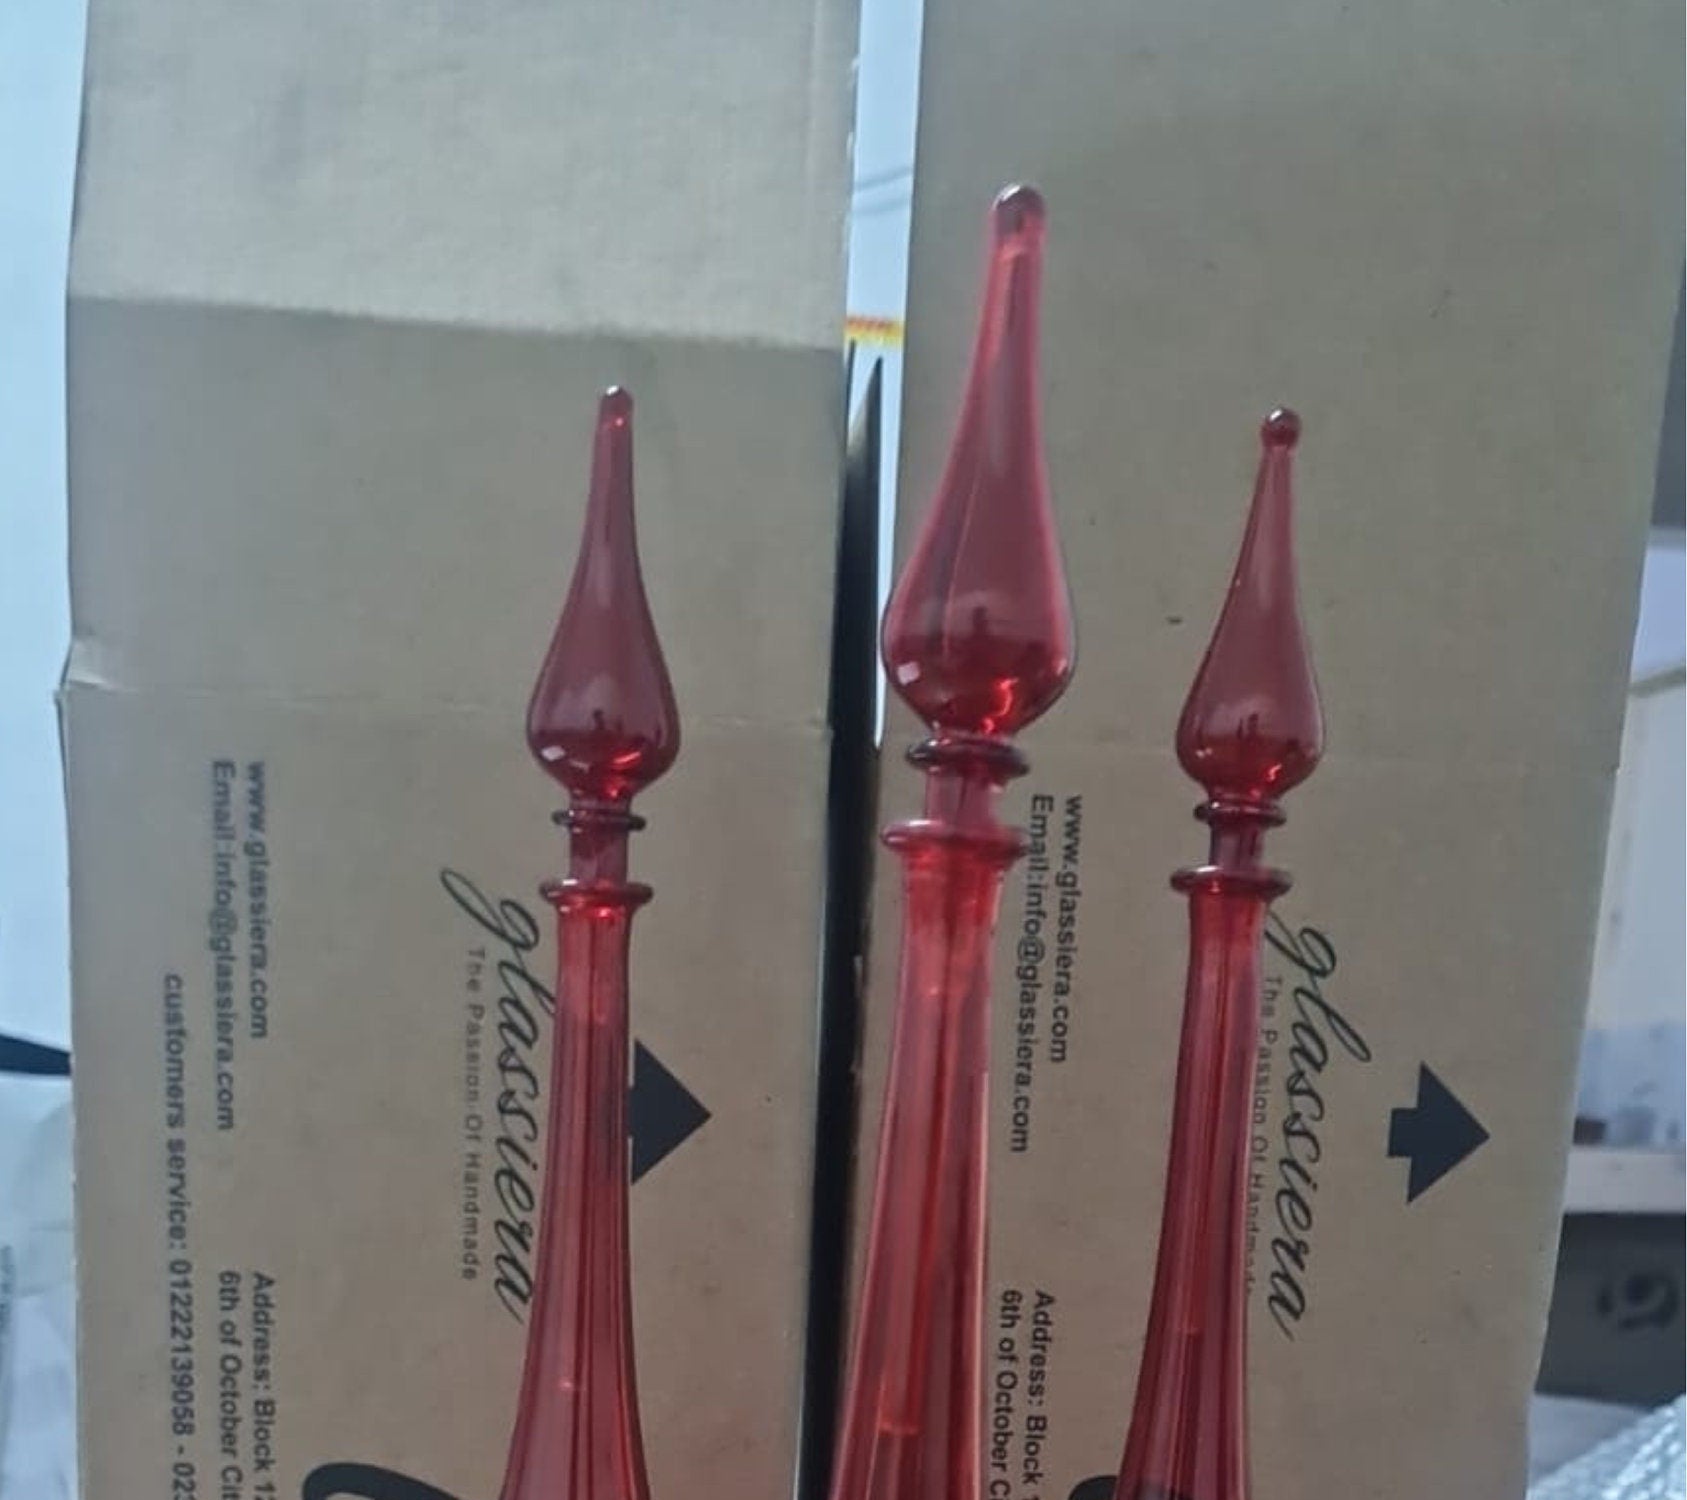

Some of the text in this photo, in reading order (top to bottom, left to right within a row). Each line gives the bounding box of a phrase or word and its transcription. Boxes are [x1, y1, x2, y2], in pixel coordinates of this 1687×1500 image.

[244, 761, 272, 1039] www.glassiera.com
[1050, 794, 1083, 1064] www.glassiera.com
[466, 947, 486, 991] The
[1010, 793, 1055, 1153] Email:info@glassiera.com
[164, 973, 188, 1129] customers
[440, 867, 557, 1325] glassiera
[464, 1114, 484, 1141] Of
[1264, 911, 1373, 1342] glassiera
[166, 1138, 191, 1250] service:
[462, 1152, 482, 1281] Handmade
[219, 1270, 242, 1311] 6th
[219, 1319, 243, 1345] of
[252, 1271, 277, 1390] Address:
[999, 1289, 1023, 1330] 6th
[169, 1260, 195, 1436] 01222139058
[997, 1337, 1020, 1364] of
[1027, 1290, 1056, 1406] Address:
[219, 1353, 243, 1457] October
[254, 1399, 277, 1473] Block
[990, 1370, 1019, 1473] October
[1023, 1415, 1048, 1485] Block
